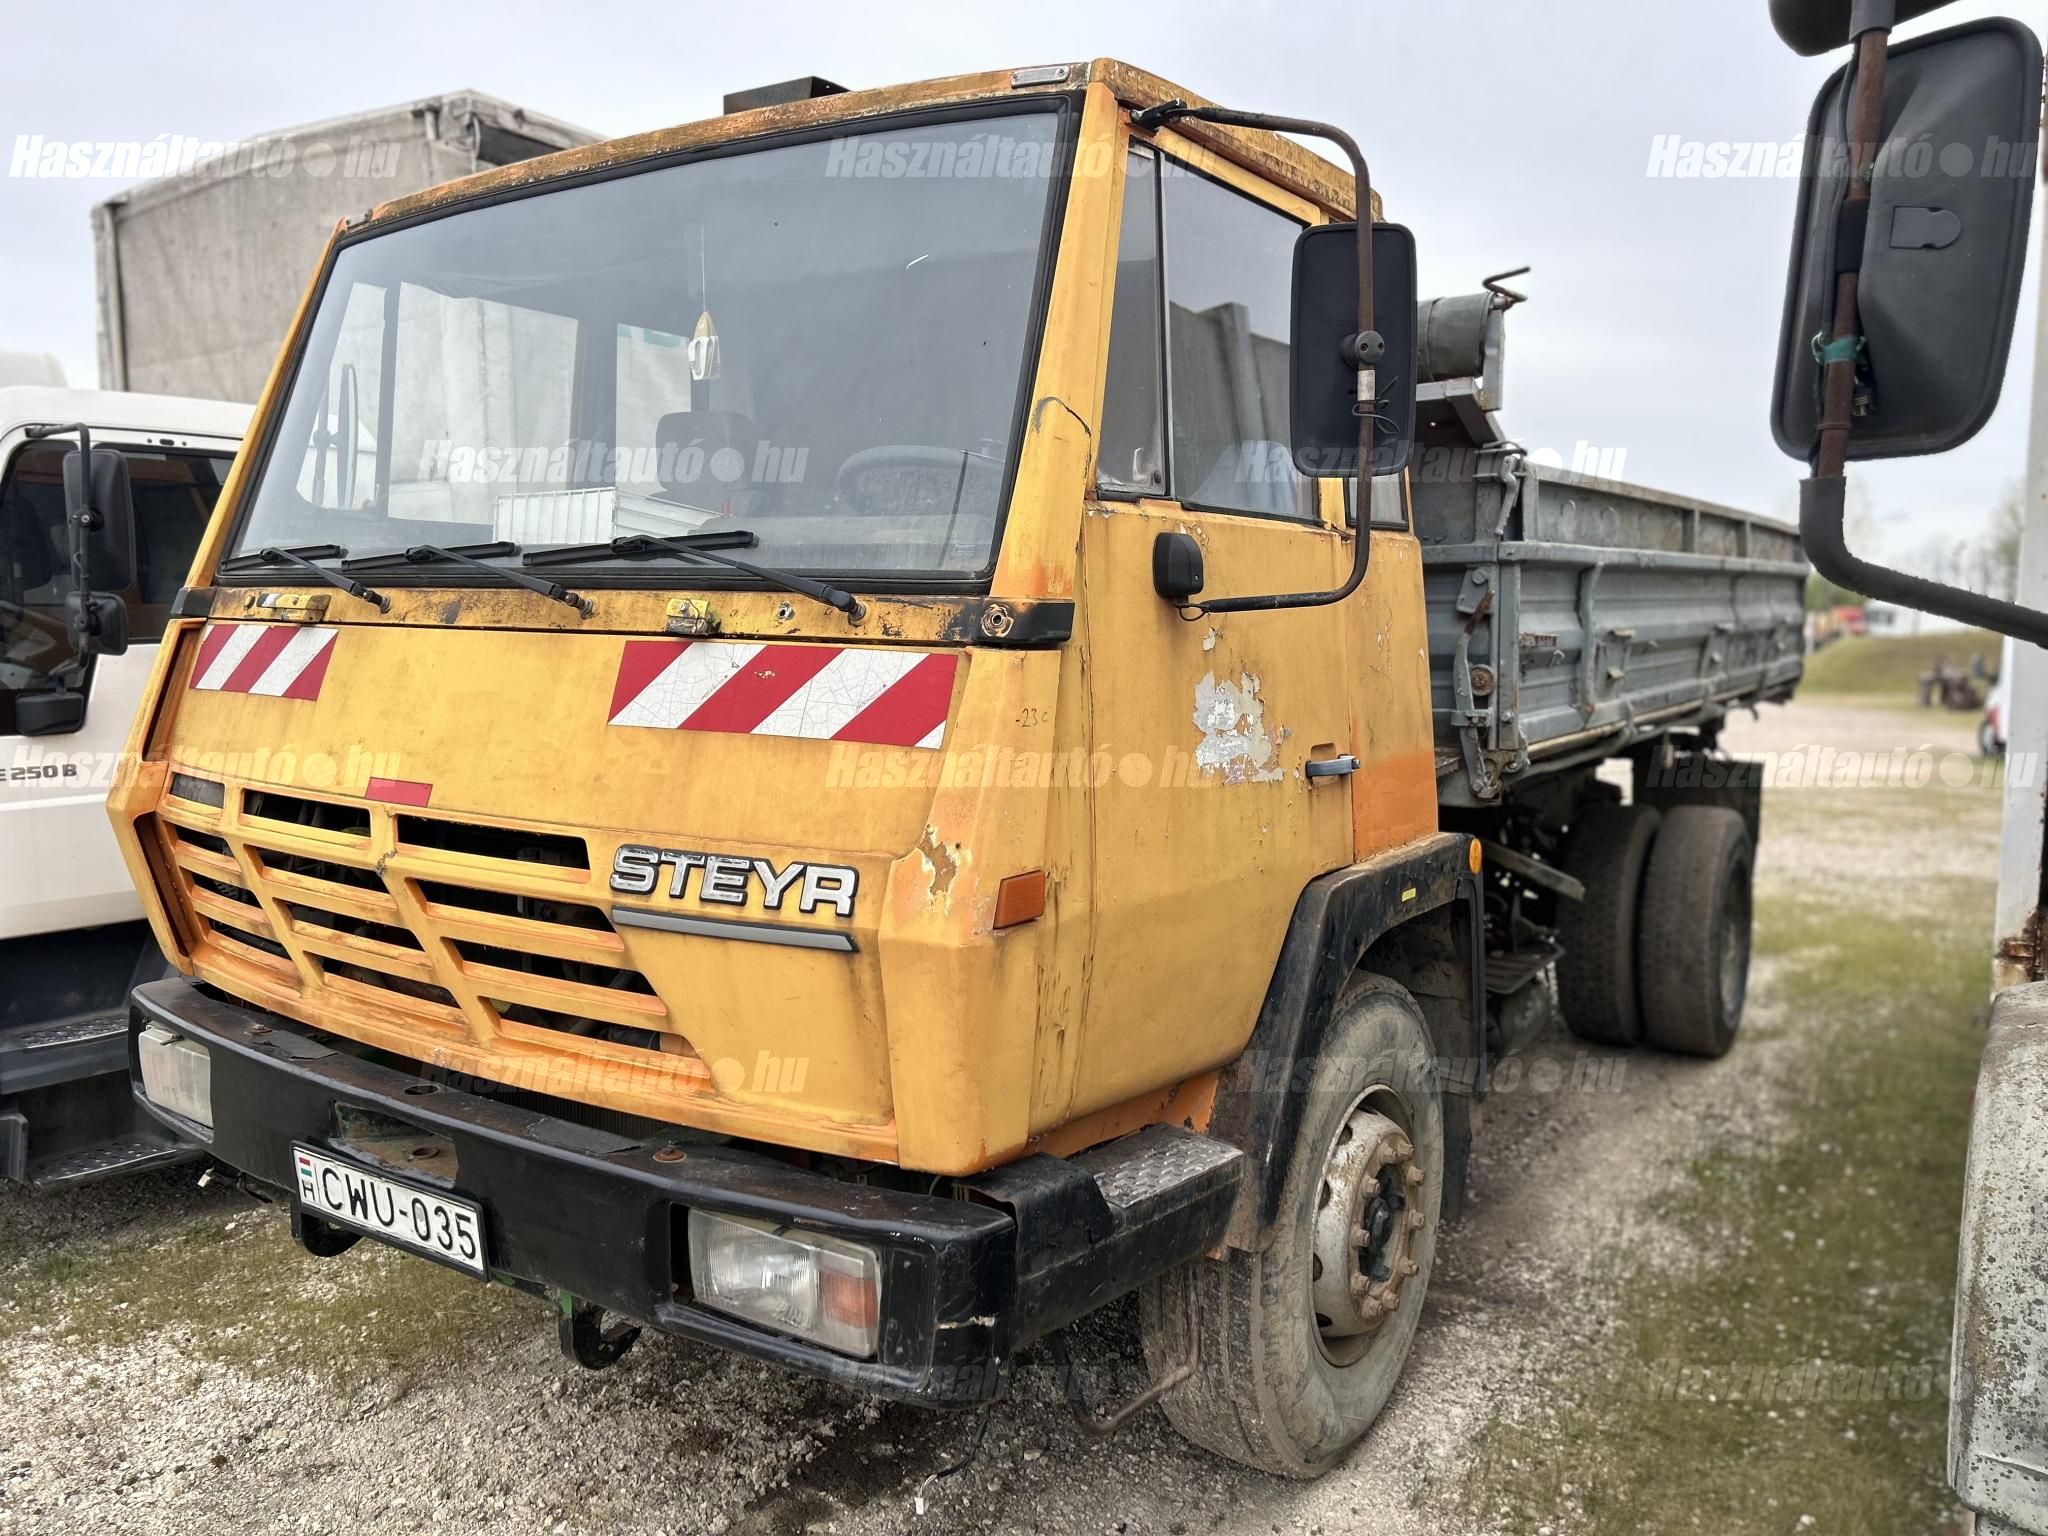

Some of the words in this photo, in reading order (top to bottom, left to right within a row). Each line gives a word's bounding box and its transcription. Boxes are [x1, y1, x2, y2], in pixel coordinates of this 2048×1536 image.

[10, 765, 58, 780] 250
[62, 764, 77, 777] B
[610, 844, 859, 917] STEYR
[302, 1180, 316, 1201] H
[322, 1167, 476, 1260] CWU-035
